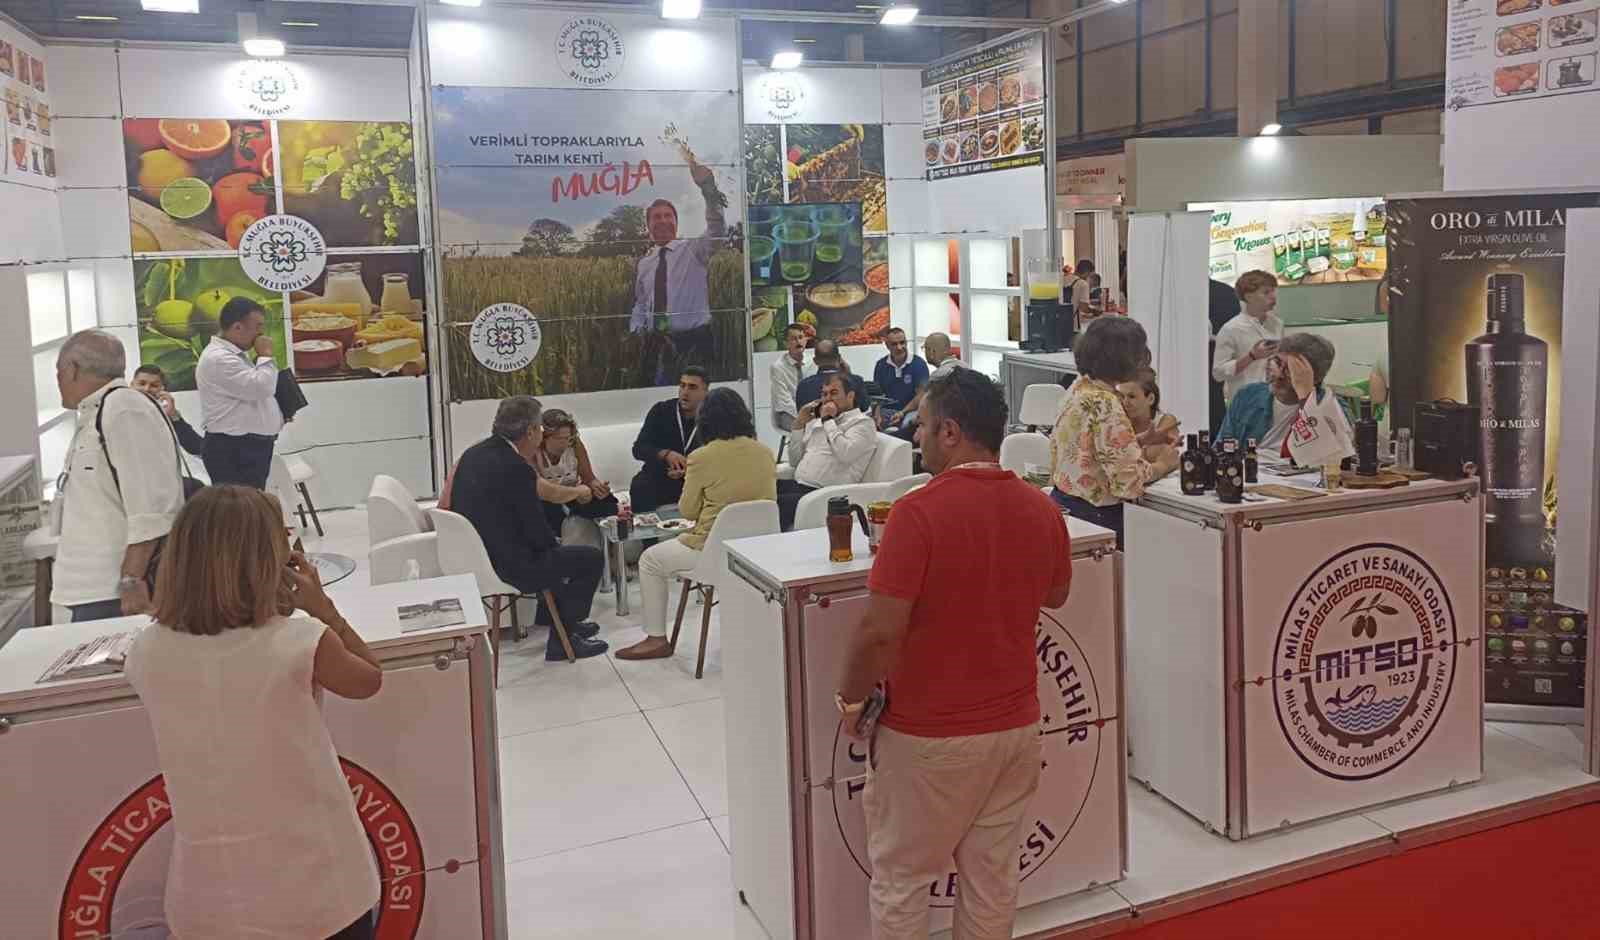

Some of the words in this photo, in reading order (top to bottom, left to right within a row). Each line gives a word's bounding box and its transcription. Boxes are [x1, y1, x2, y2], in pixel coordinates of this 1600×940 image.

[469, 133, 528, 147] VERİMLİ
[531, 135, 645, 147] TOPRAKLARIYLA
[515, 153, 559, 165] TARIM
[564, 152, 604, 165] KENTİ
[552, 159, 655, 203] MUĞLA
[1430, 211, 1481, 230] ORO
[1504, 209, 1565, 227] MILA
[1234, 237, 1271, 251] Knows
[1458, 234, 1484, 246] EXTRA
[1284, 609, 1310, 660] MİLAS
[1308, 559, 1359, 605] TİCARET
[1361, 555, 1380, 571] VE
[1381, 556, 1430, 589] SANAYİ
[1422, 587, 1447, 634] ODASI
[1387, 670, 1416, 687] 1923
[1298, 724, 1337, 765] CHAMBER
[1337, 753, 1351, 768] OF
[1352, 739, 1407, 768] COMMERCE
[1406, 722, 1425, 742] AND
[1422, 660, 1447, 721] INDUSTRY
[101, 793, 170, 856] TİCA
[378, 822, 413, 911] ODASI
